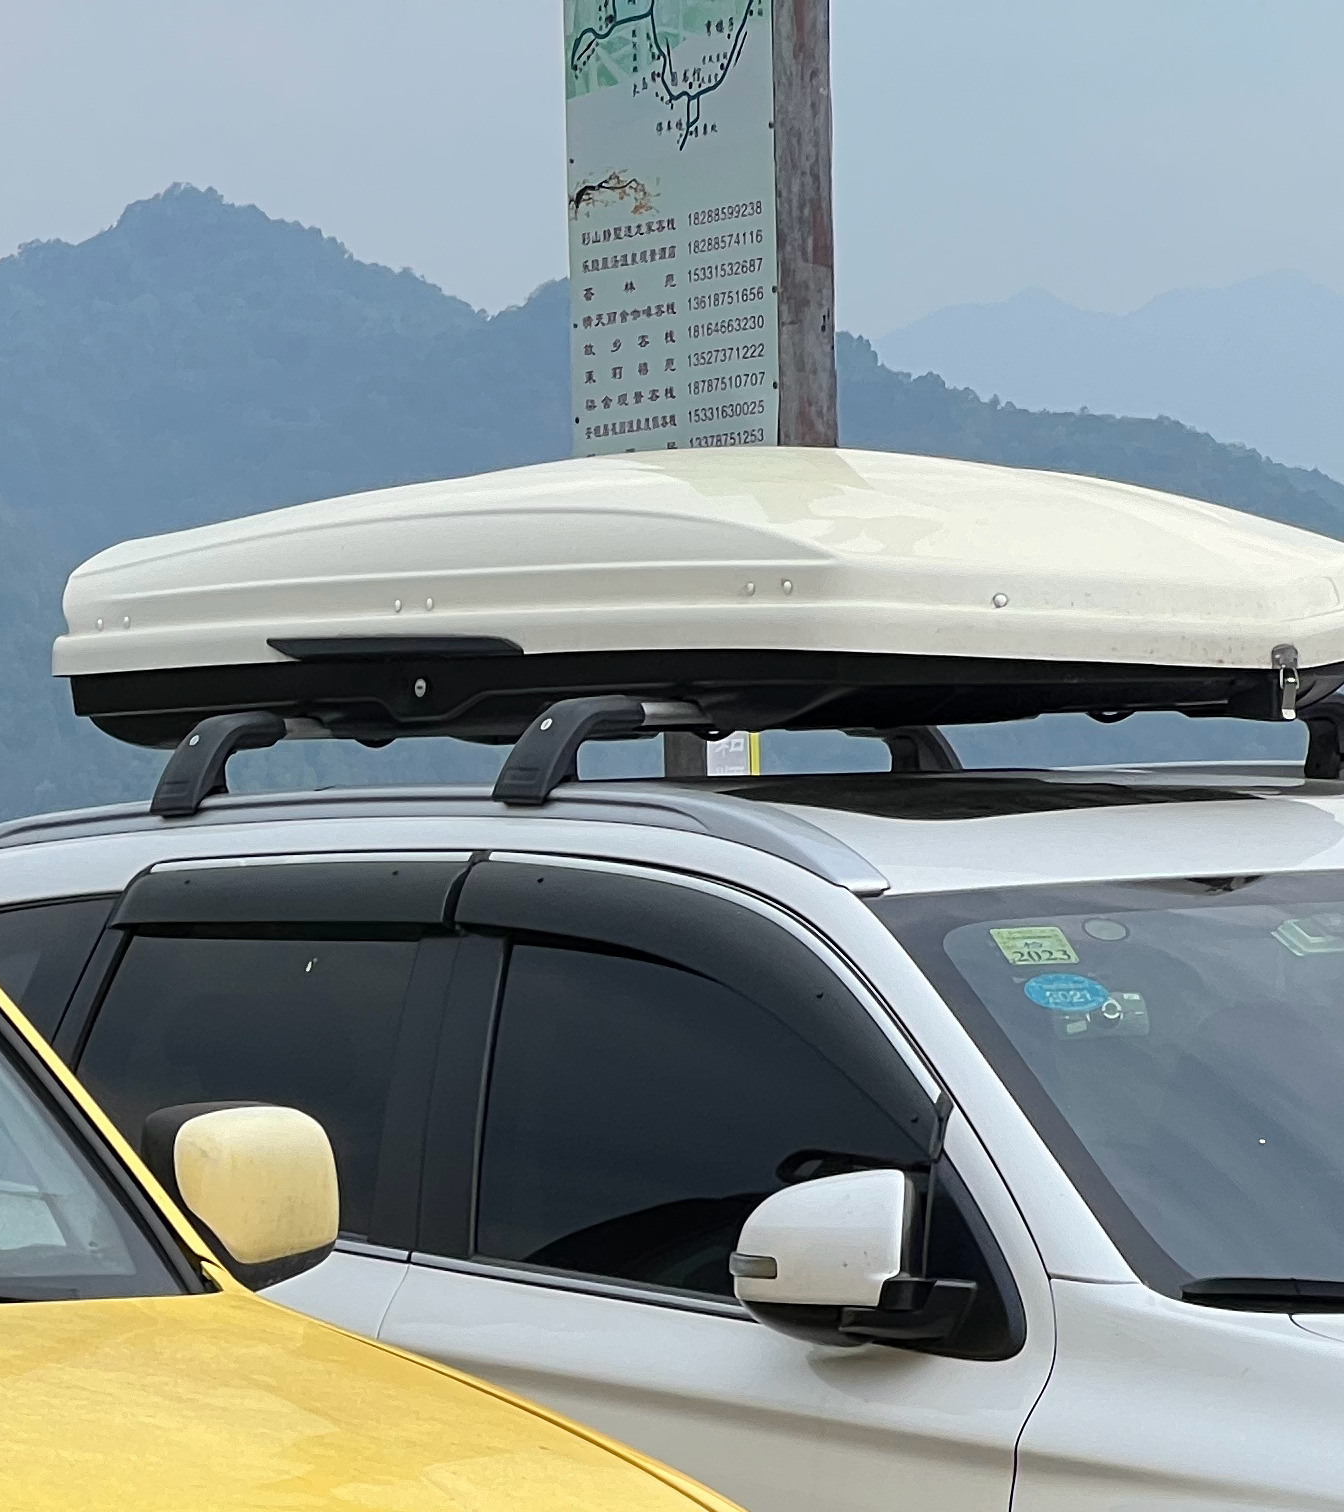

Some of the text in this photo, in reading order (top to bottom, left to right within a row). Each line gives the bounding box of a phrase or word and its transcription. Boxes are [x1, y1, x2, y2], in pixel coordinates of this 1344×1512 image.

[688, 201, 762, 226] 18288599238
[688, 229, 763, 254] 18288574116
[688, 258, 763, 283] 15331532687
[688, 286, 763, 310] 13618751656
[688, 315, 764, 338] 18164663230
[688, 343, 764, 367] 13527371222
[688, 372, 765, 395] 18787510707
[688, 400, 764, 423] 15331630025
[1011, 949, 1072, 963] 2023
